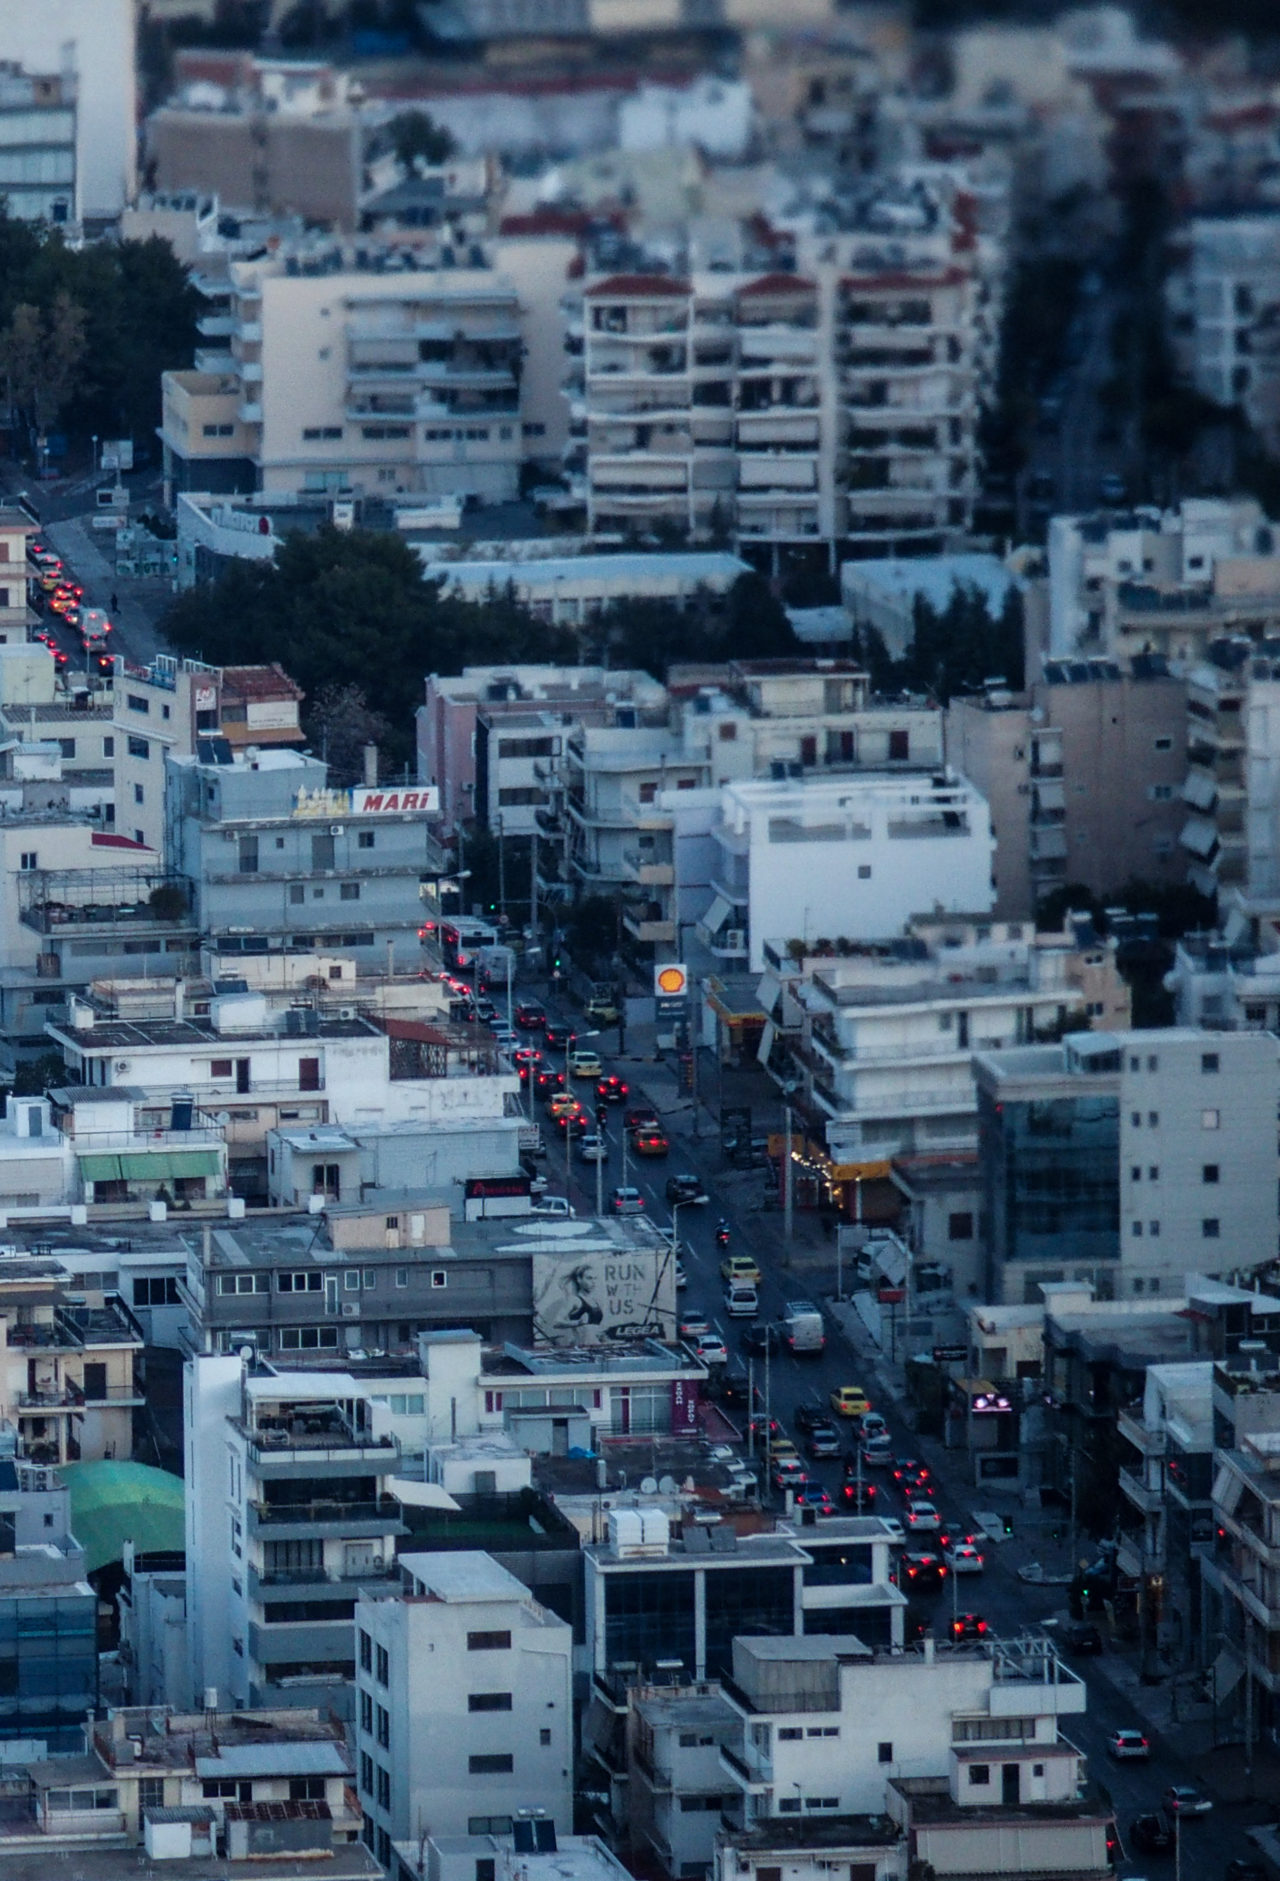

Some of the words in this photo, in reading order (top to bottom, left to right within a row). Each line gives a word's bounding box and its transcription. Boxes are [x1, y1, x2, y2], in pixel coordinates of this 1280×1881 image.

[604, 1264, 645, 1281] RUN
[606, 1283, 642, 1297] WTH
[609, 1299, 634, 1315] US
[615, 1325, 660, 1336] LEGEA
